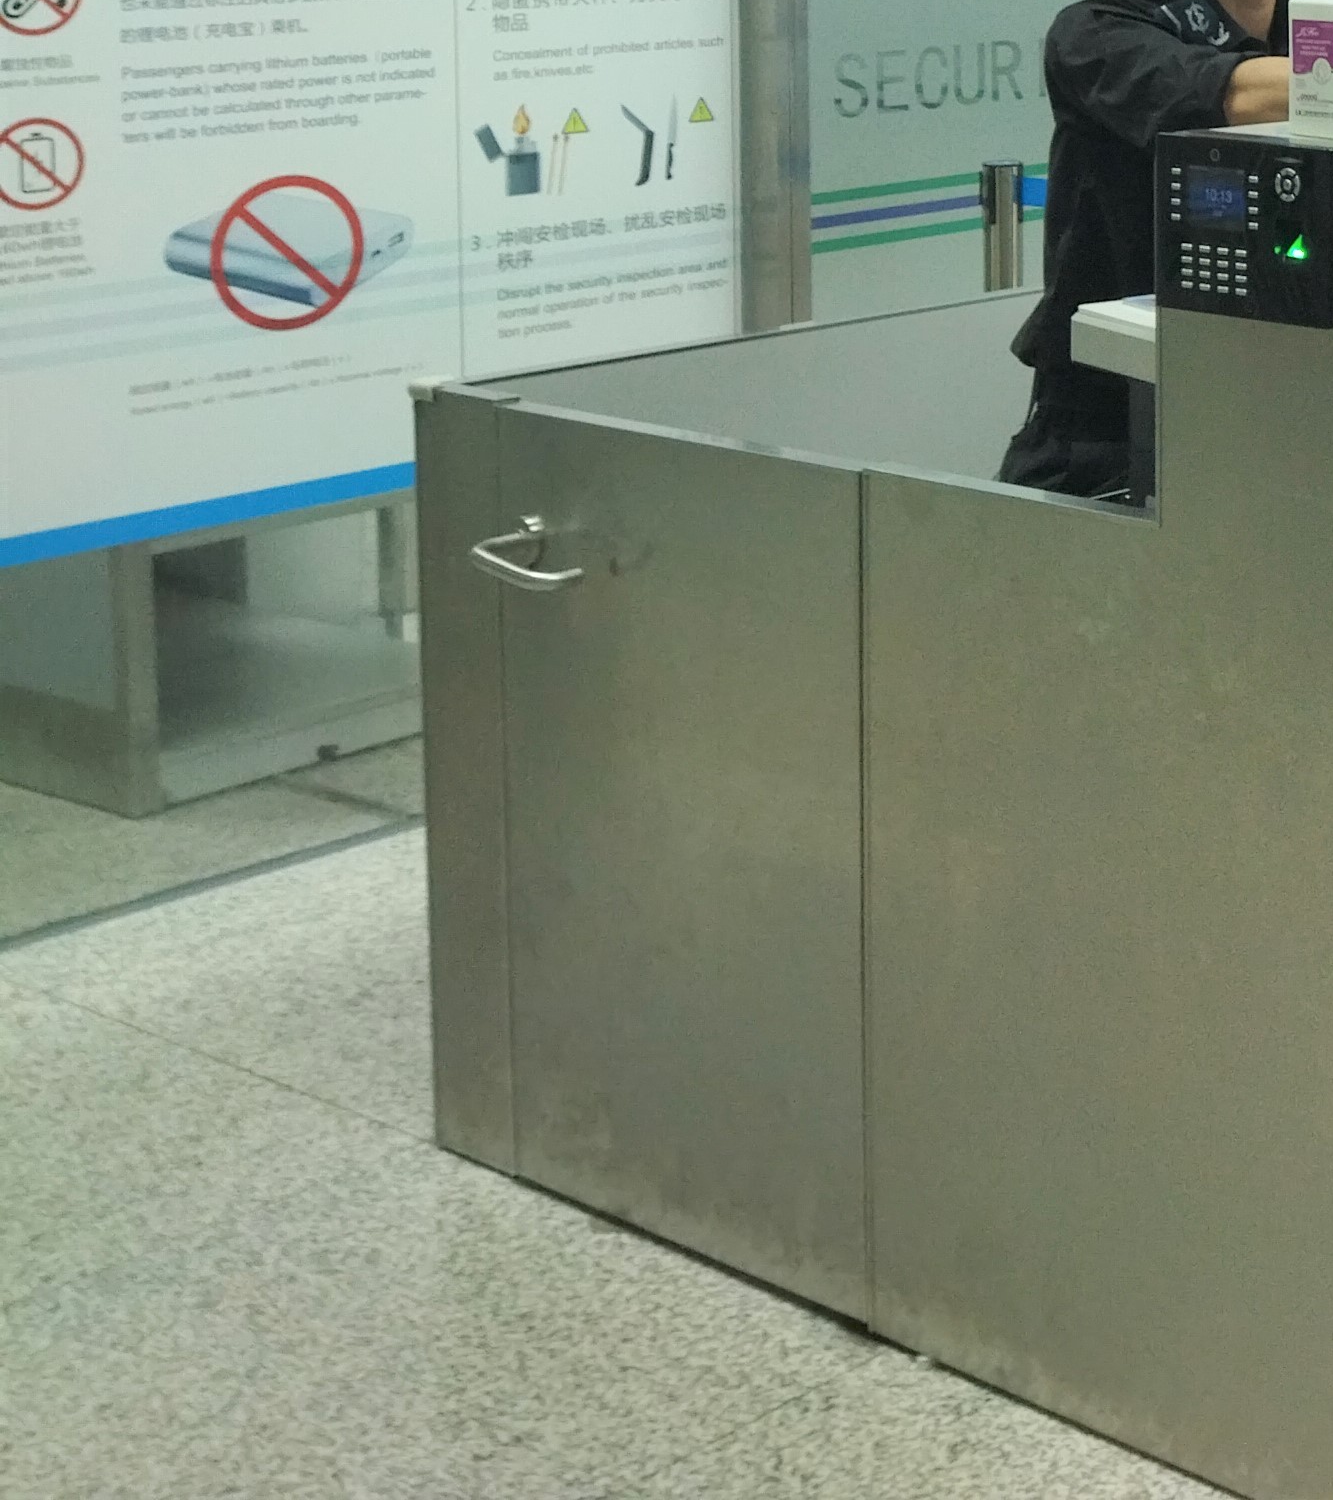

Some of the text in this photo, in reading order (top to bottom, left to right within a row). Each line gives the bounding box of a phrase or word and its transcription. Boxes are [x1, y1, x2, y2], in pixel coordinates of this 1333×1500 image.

[492, 36, 724, 63] Concealment of prohibited articles such
[121, 62, 205, 81] Passengers
[207, 60, 263, 76] carrying
[265, 56, 309, 70] lithium
[311, 52, 368, 67] batteries
[213, 81, 257, 95] whose
[259, 77, 295, 92] rated
[297, 75, 337, 90] power
[341, 73, 352, 85] is
[355, 71, 377, 84] not
[379, 66, 436, 83] indicated
[493, 70, 508, 82] as
[121, 111, 137, 124] or
[140, 106, 190, 121] cannot
[192, 104, 210, 118] be
[213, 98, 282, 116] calculated
[284, 94, 335, 111] through
[337, 92, 372, 106] other
[154, 128, 177, 141] will
[179, 126, 198, 140] be
[200, 120, 265, 138] forbidden
[268, 118, 299, 132] from
[497, 259, 727, 301] Disrupt the security inspection area and
[497, 304, 540, 321] normal
[543, 296, 600, 314] operation
[602, 292, 616, 305] of
[618, 288, 637, 302] the
[640, 283, 684, 299] security
